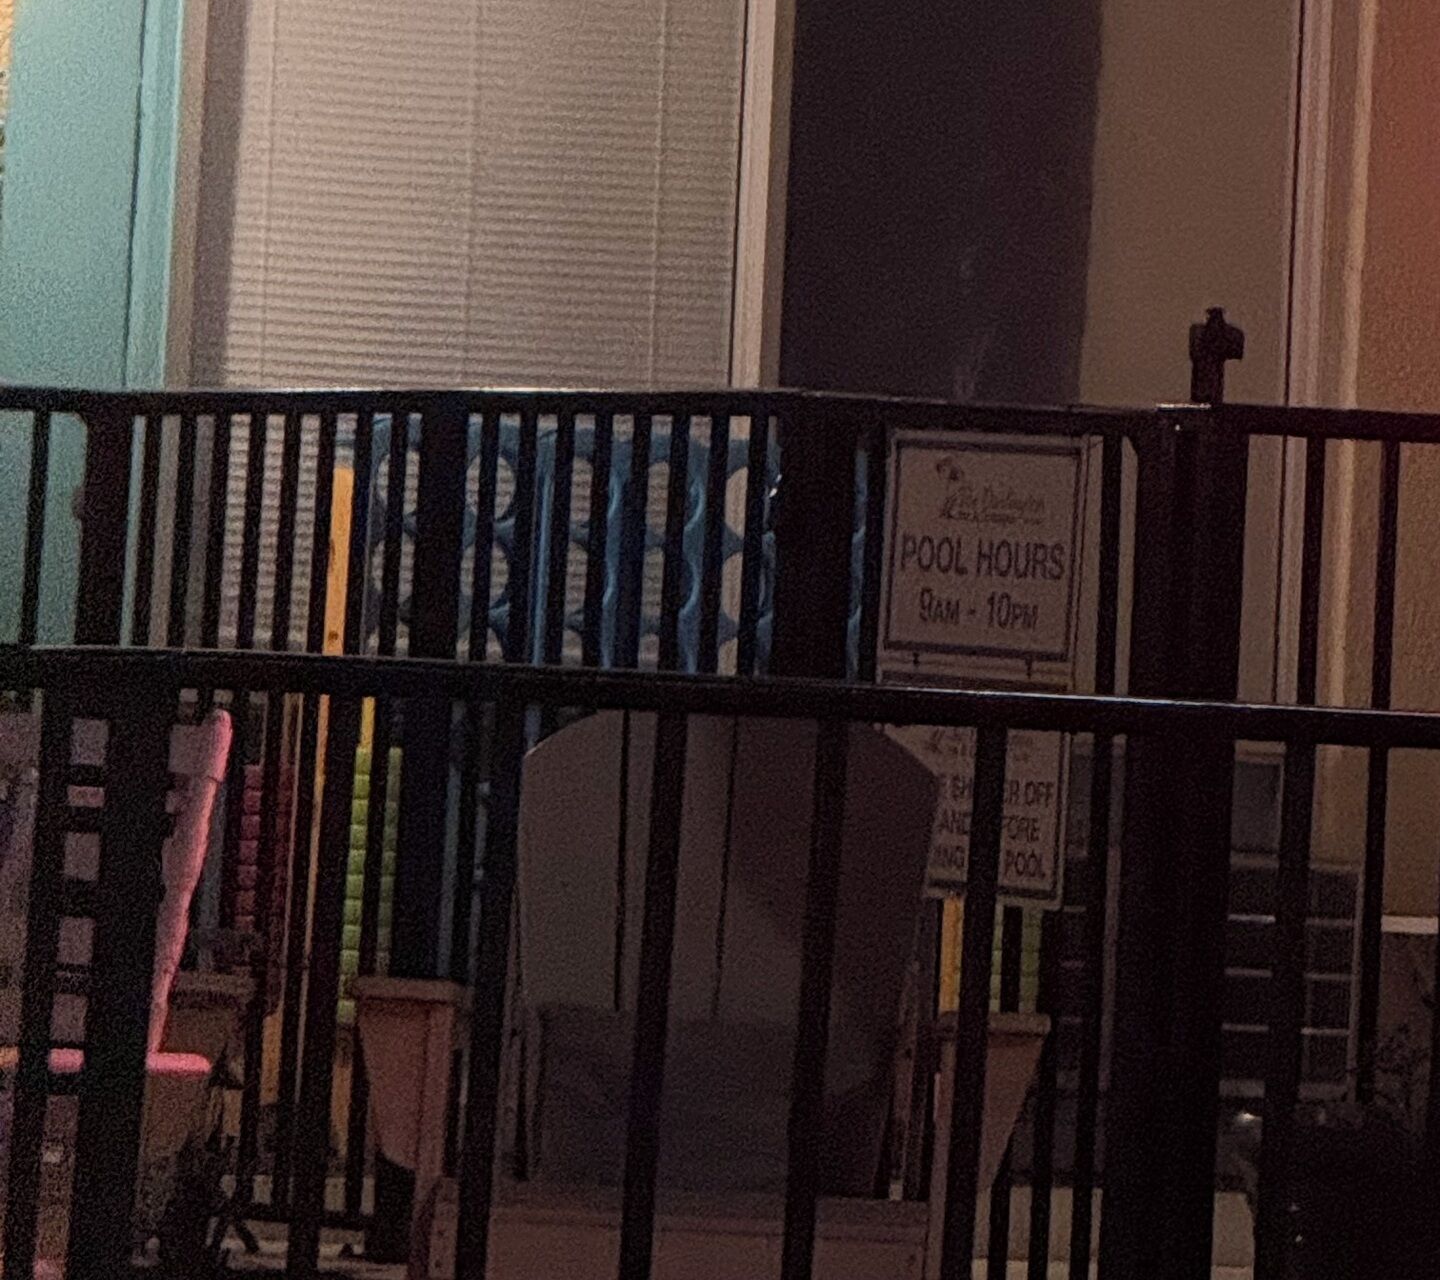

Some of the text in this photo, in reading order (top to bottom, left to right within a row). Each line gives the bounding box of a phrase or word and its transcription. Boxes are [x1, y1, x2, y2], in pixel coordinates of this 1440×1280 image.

[901, 534, 1066, 581] POOL HOURS
[986, 591, 1040, 631] 10PM
